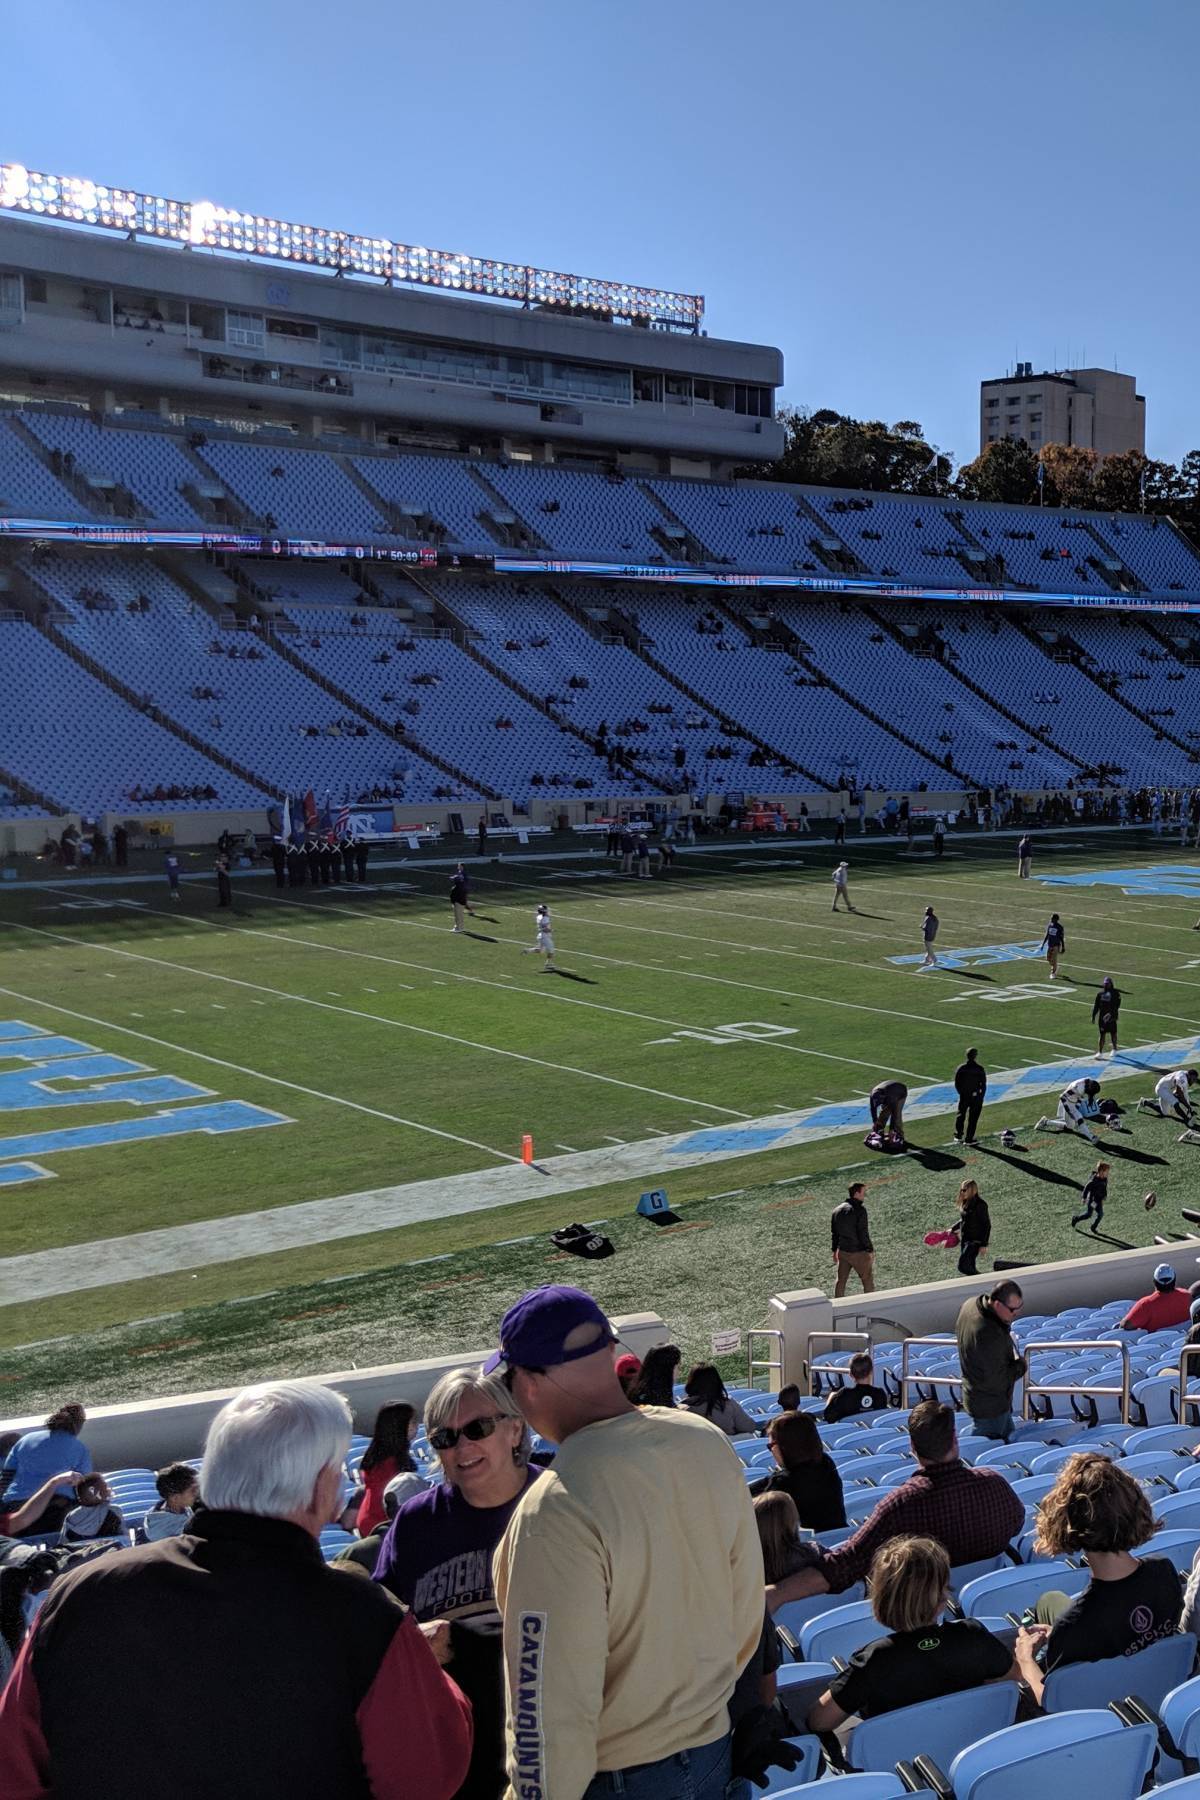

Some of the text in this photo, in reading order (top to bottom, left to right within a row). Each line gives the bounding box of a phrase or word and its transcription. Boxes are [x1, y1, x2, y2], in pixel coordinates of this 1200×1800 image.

[88, 526, 149, 543] SIMMONS
[272, 540, 281, 554] 0
[355, 547, 364, 559] 0
[1073, 595, 1111, 608] WELCOME
[957, 983, 1078, 1003] 20
[671, 1021, 801, 1045] 10
[650, 1191, 664, 1210] G
[413, 1549, 489, 1613] WESTERN
[432, 1589, 496, 1614] FOOT
[517, 1615, 543, 1800] CATAMOUNTS
